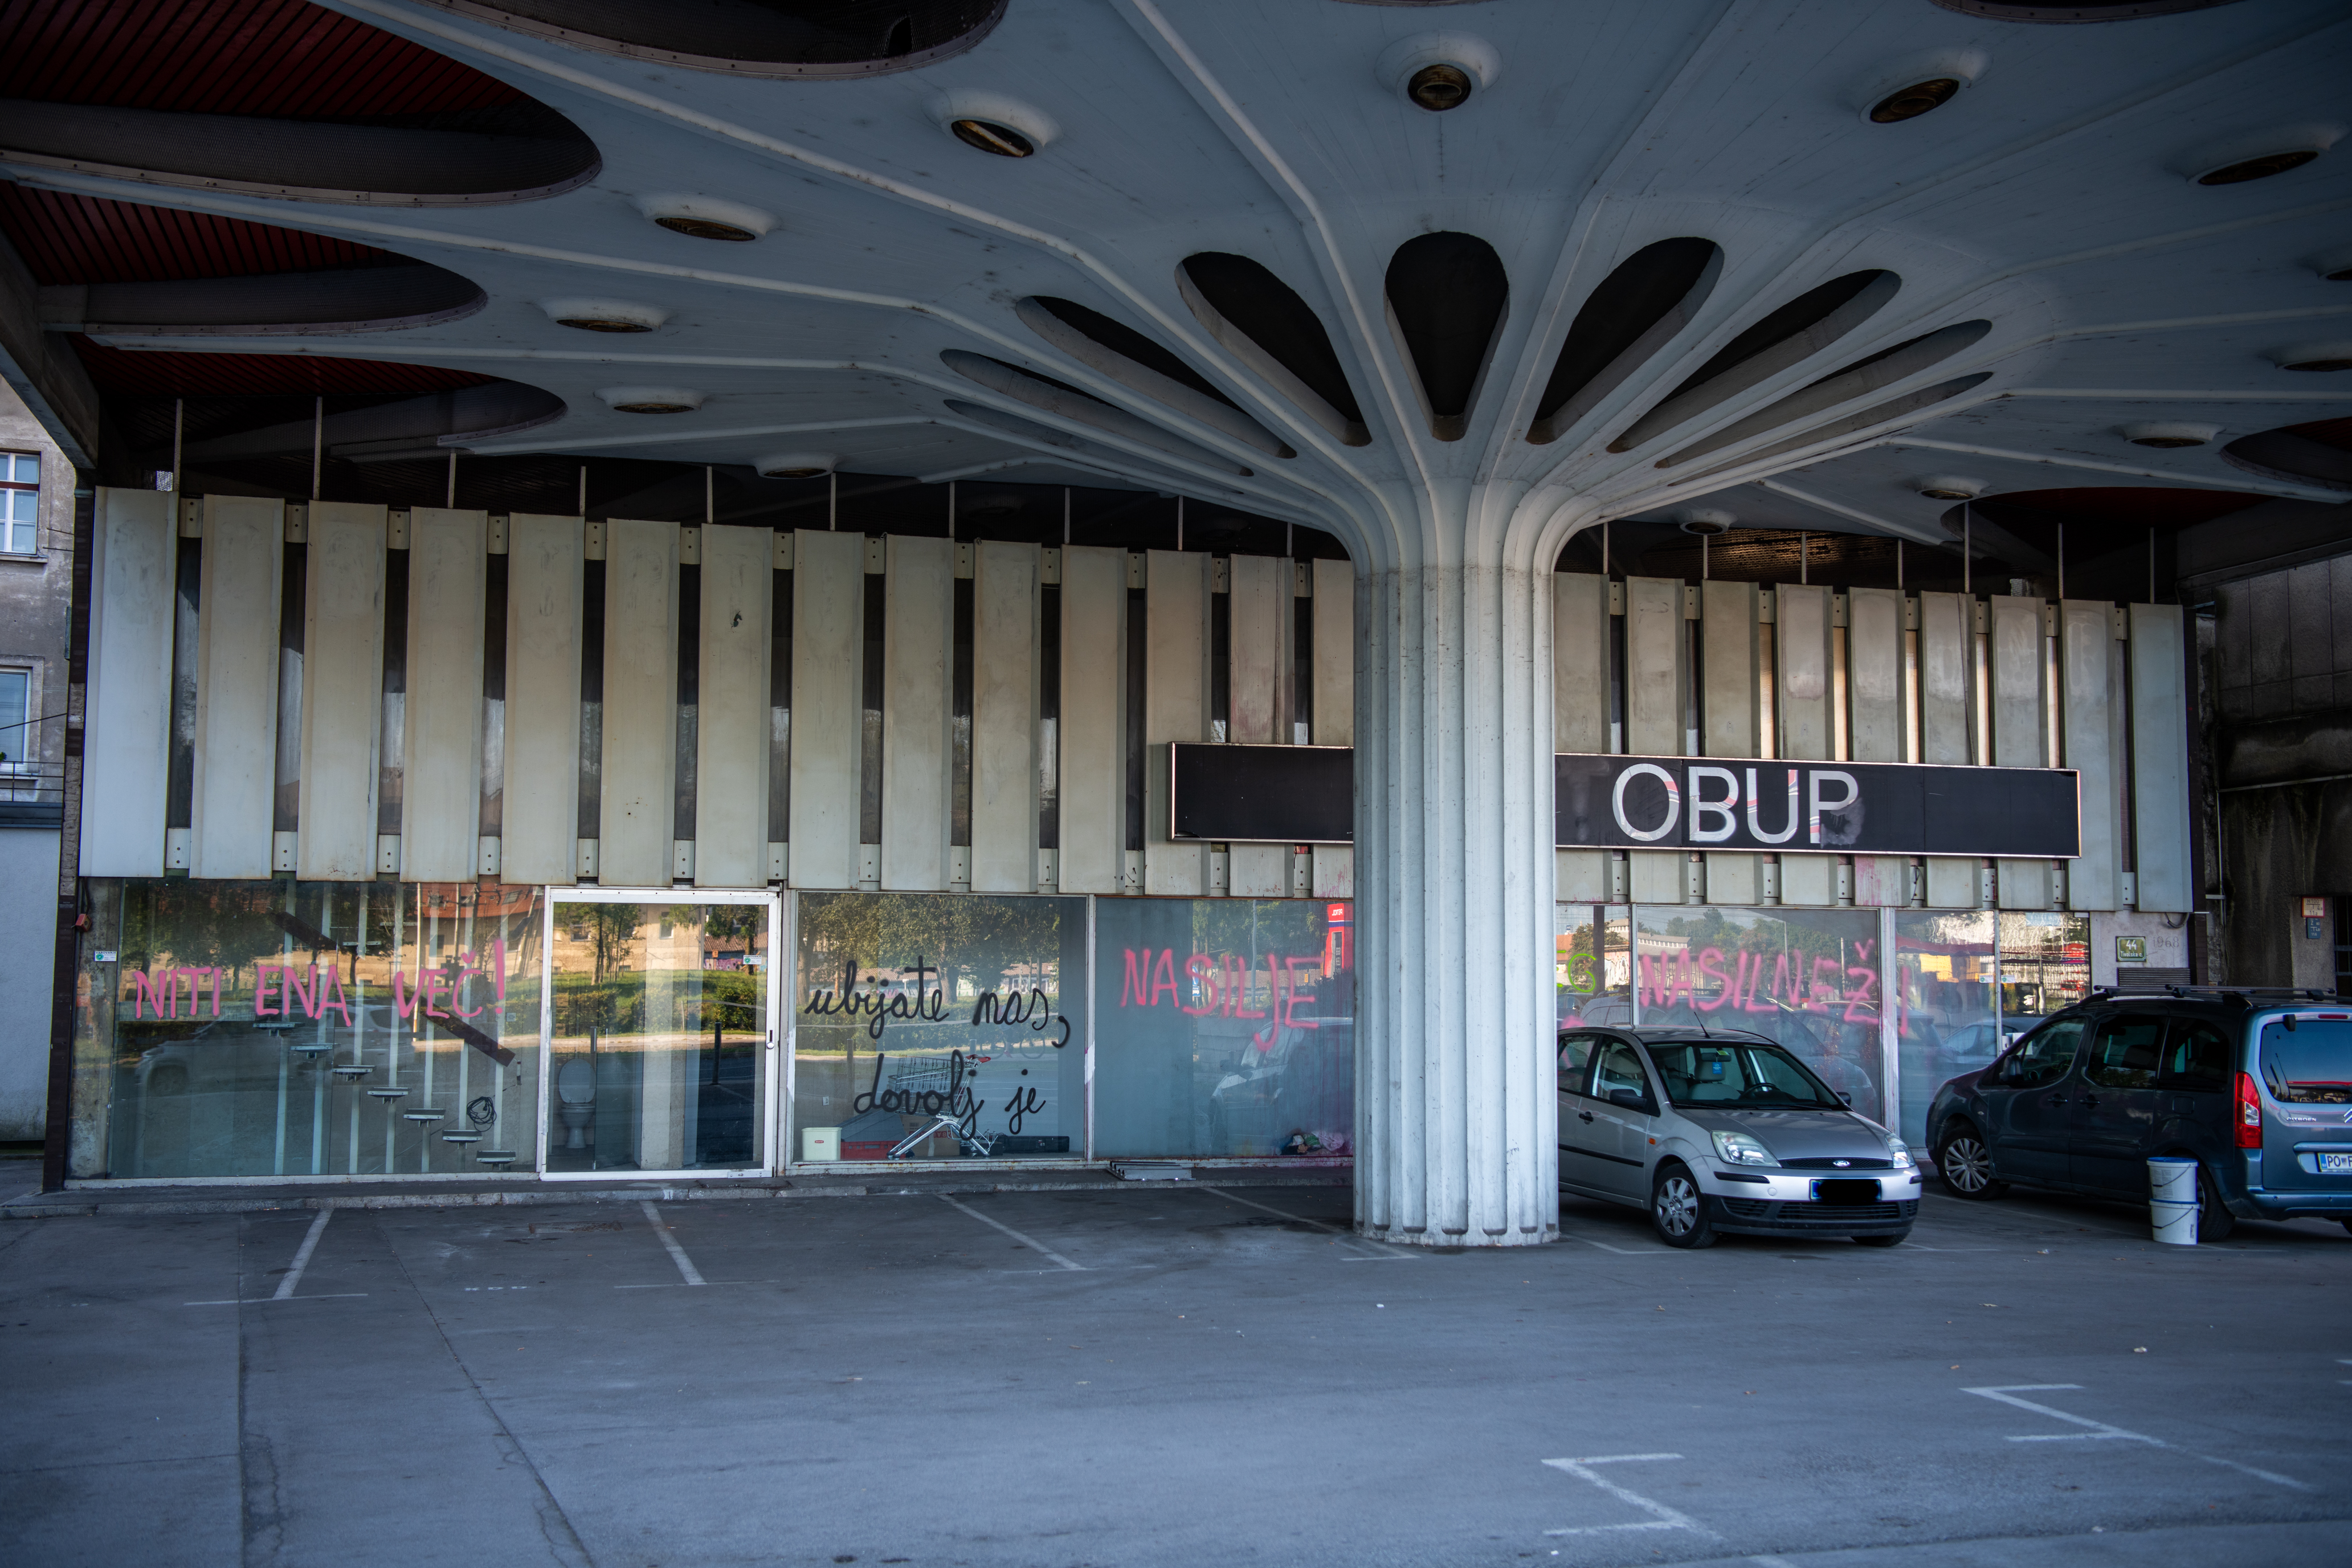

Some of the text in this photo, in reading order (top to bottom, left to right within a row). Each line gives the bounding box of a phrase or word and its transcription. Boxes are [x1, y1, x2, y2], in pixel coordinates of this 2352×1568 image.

[1612, 763, 1859, 844] OBUP
[133, 938, 506, 1027] NITI ENA VEČ!
[2125, 940, 2137, 950] 44
[804, 955, 950, 1039] ubijate
[1120, 949, 1325, 1051] NASILJE
[854, 1049, 1047, 1140] dovolj je
